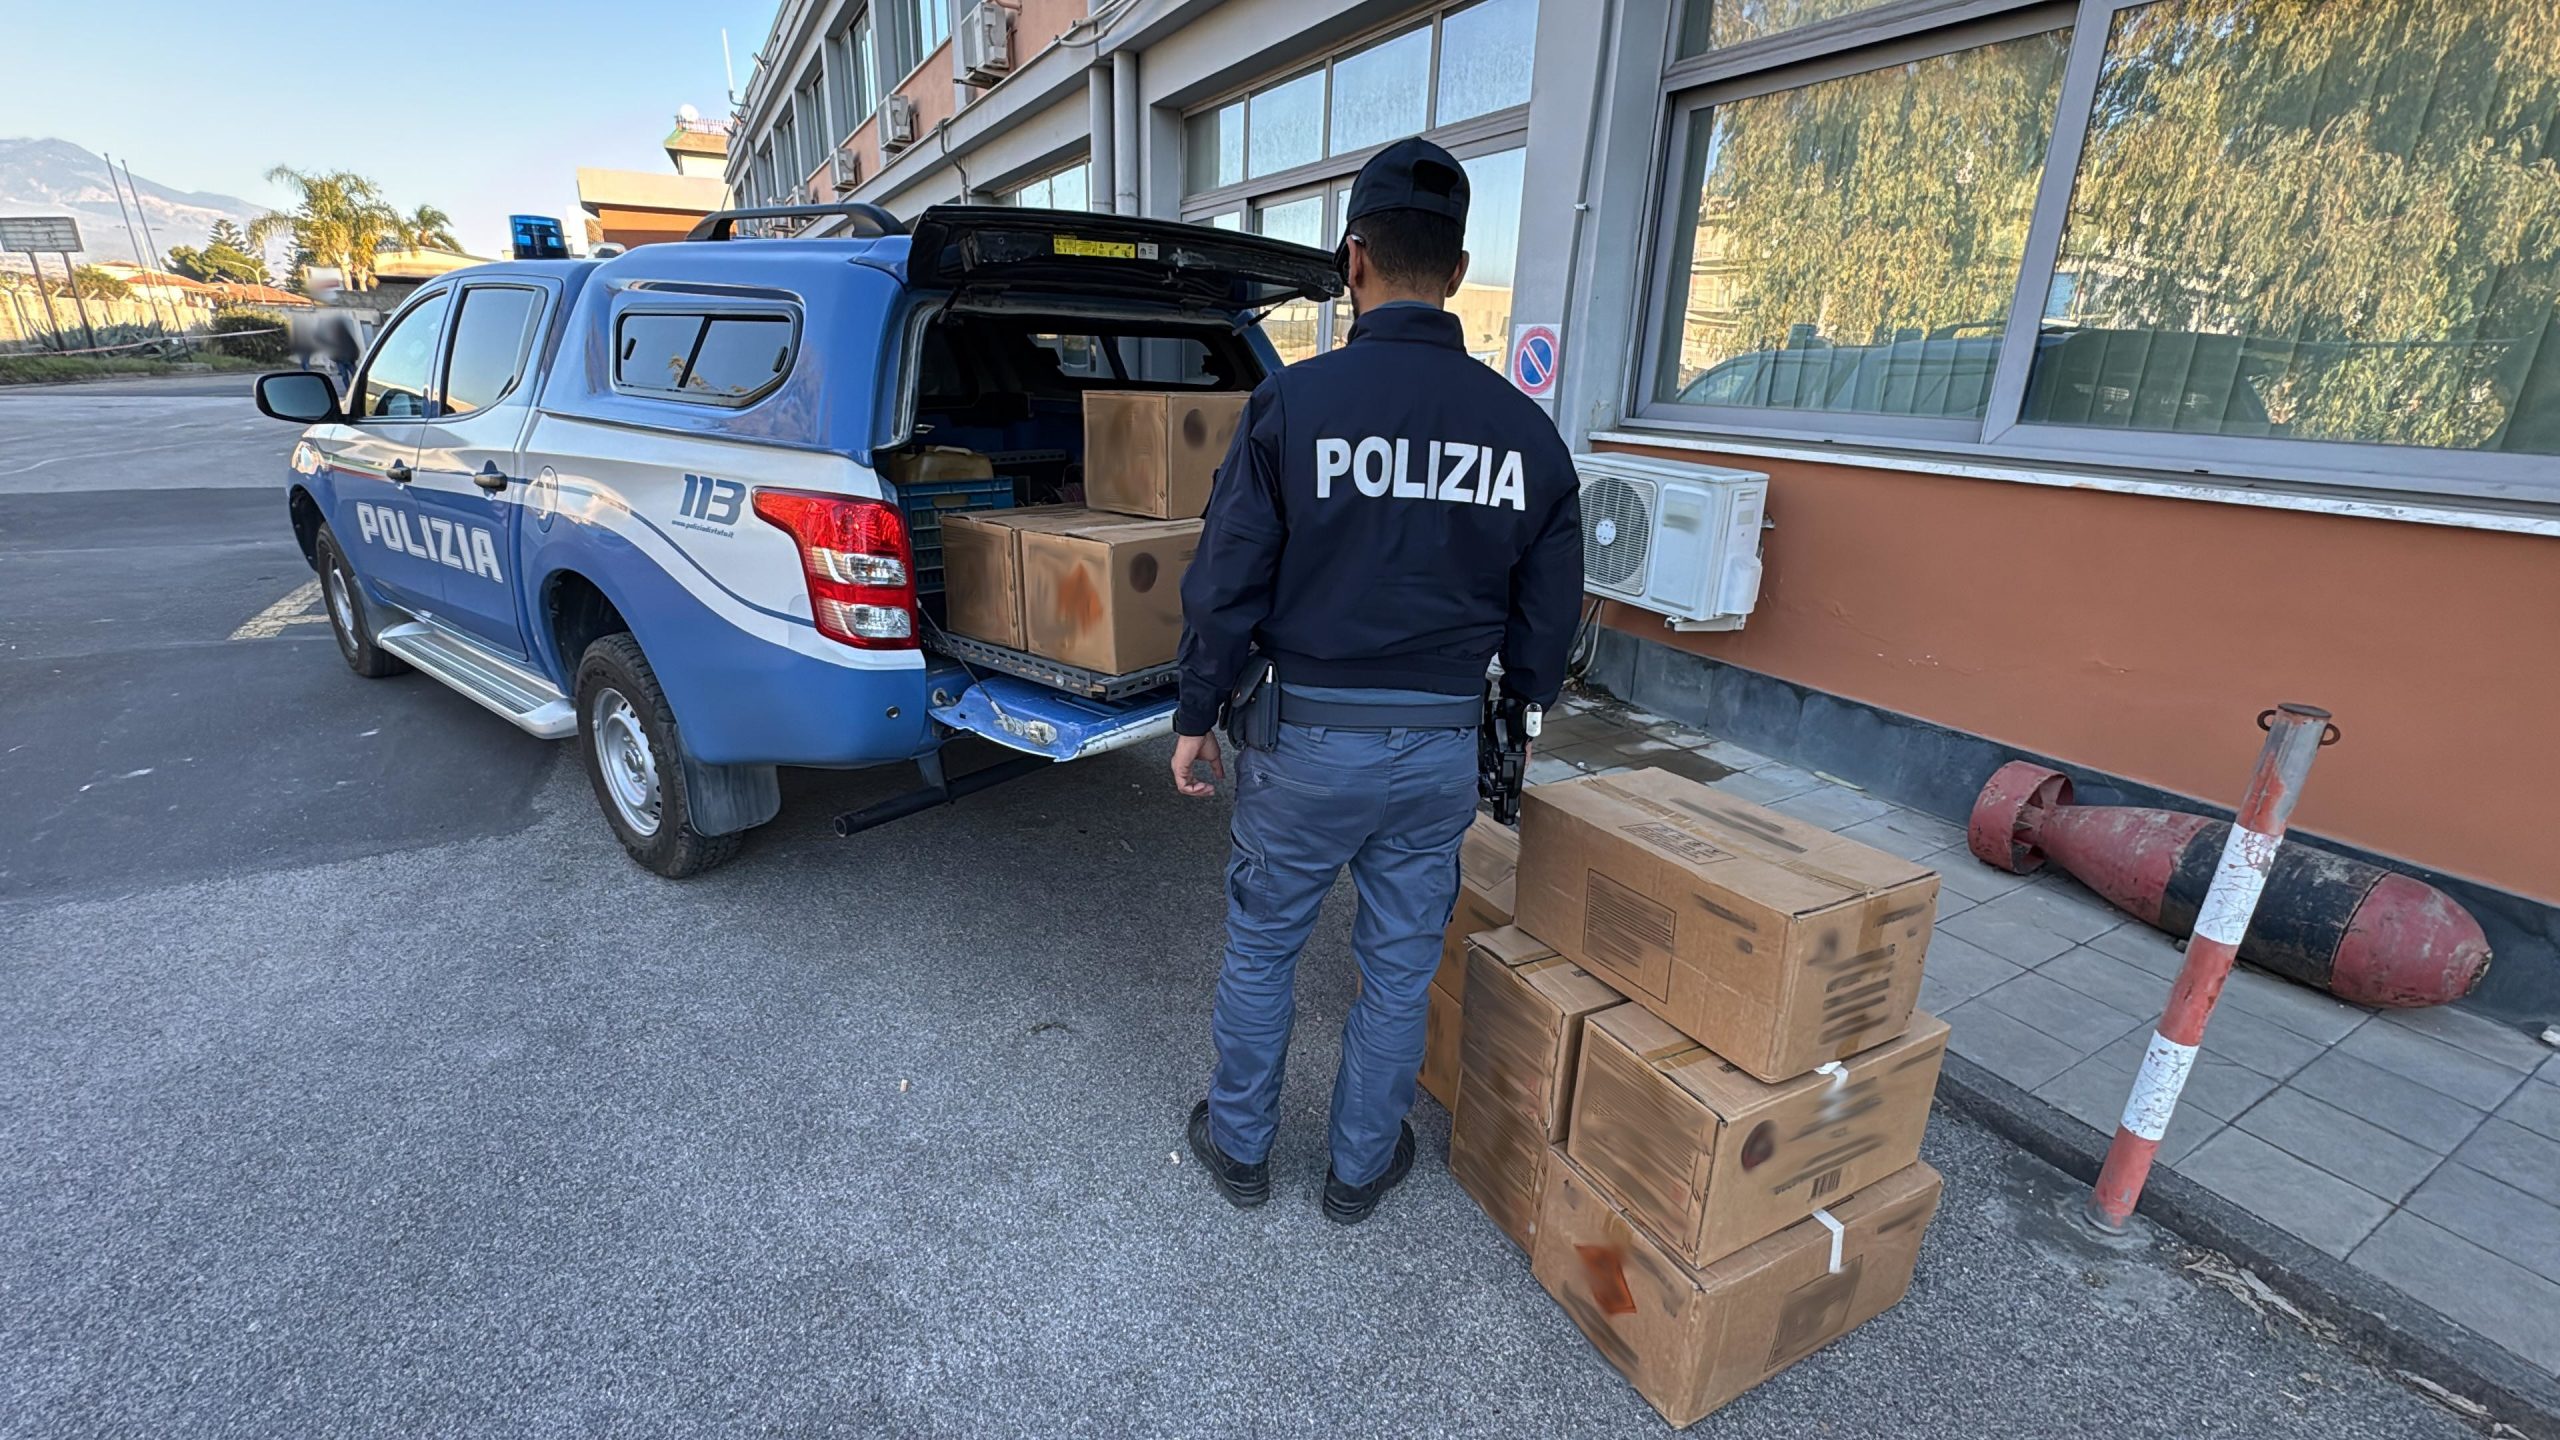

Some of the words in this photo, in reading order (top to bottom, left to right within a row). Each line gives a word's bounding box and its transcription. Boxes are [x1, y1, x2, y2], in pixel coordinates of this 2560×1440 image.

[680, 473, 747, 526] 113
[1316, 436, 1526, 511] POLIZIA
[356, 501, 504, 583] POLIZIA
